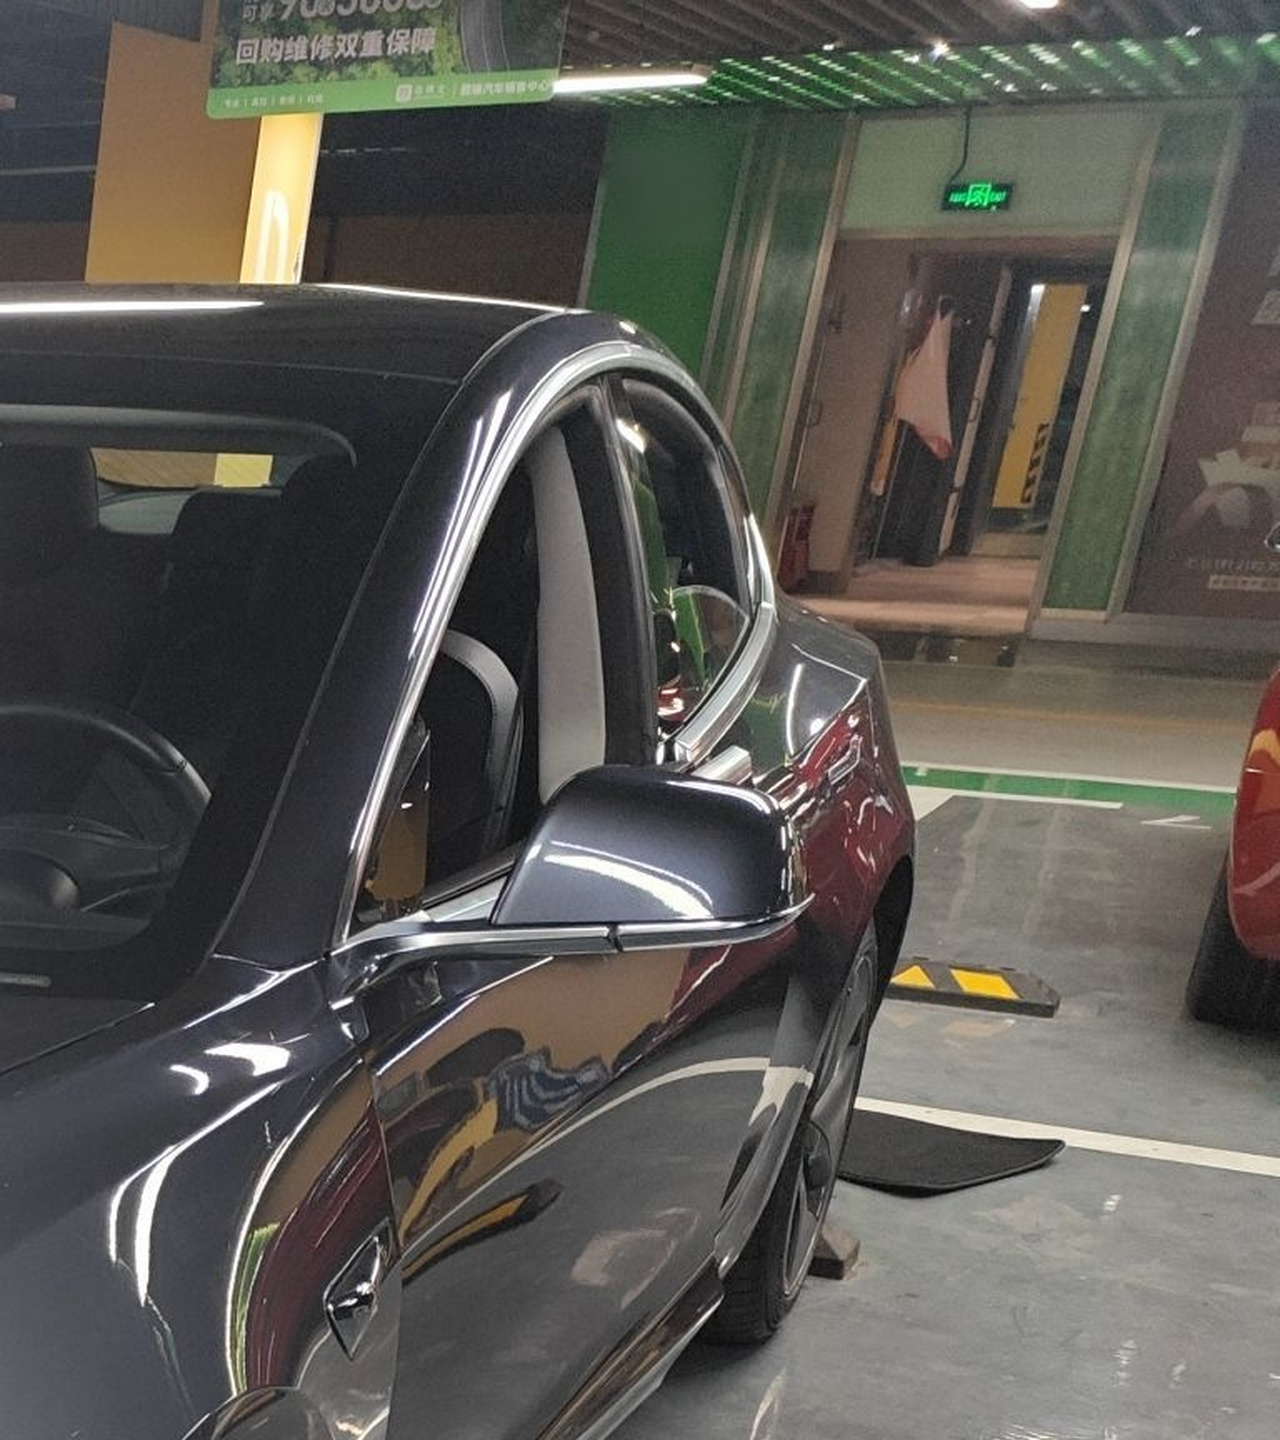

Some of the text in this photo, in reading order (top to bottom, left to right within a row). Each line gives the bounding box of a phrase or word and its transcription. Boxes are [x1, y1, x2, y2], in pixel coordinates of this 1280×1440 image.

[236, 26, 438, 66] 回购维修双重保障
